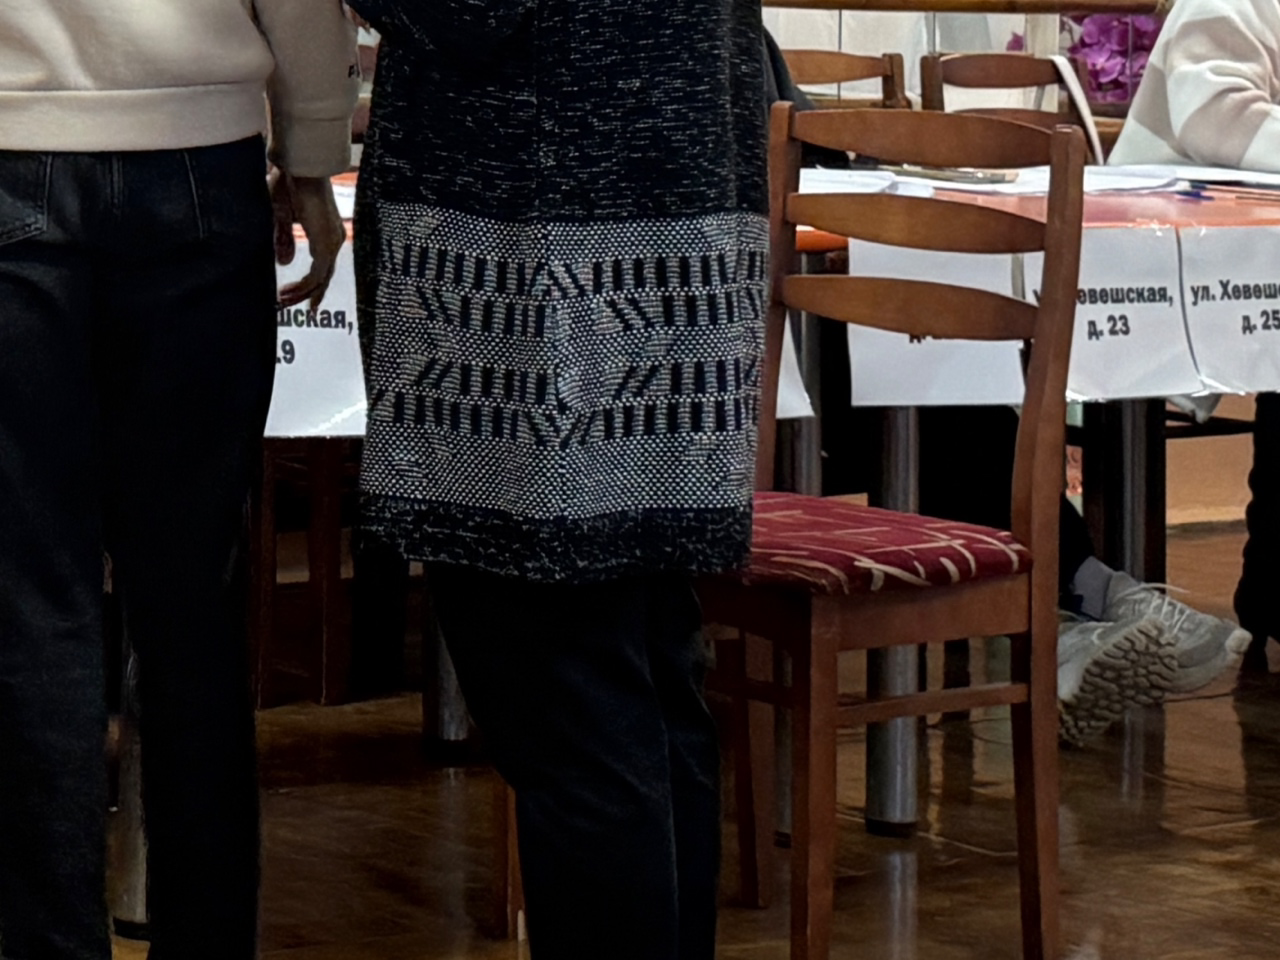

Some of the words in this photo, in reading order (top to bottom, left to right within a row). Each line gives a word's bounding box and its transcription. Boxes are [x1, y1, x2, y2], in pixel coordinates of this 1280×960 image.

[1076, 286, 1173, 307] евешская,
[1190, 284, 1216, 307] ул.
[1218, 279, 1280, 301] Хевеш
[1087, 320, 1104, 340] д.
[1107, 313, 1130, 336] 23
[1241, 314, 1257, 335] д.
[276, 339, 296, 365] 9
